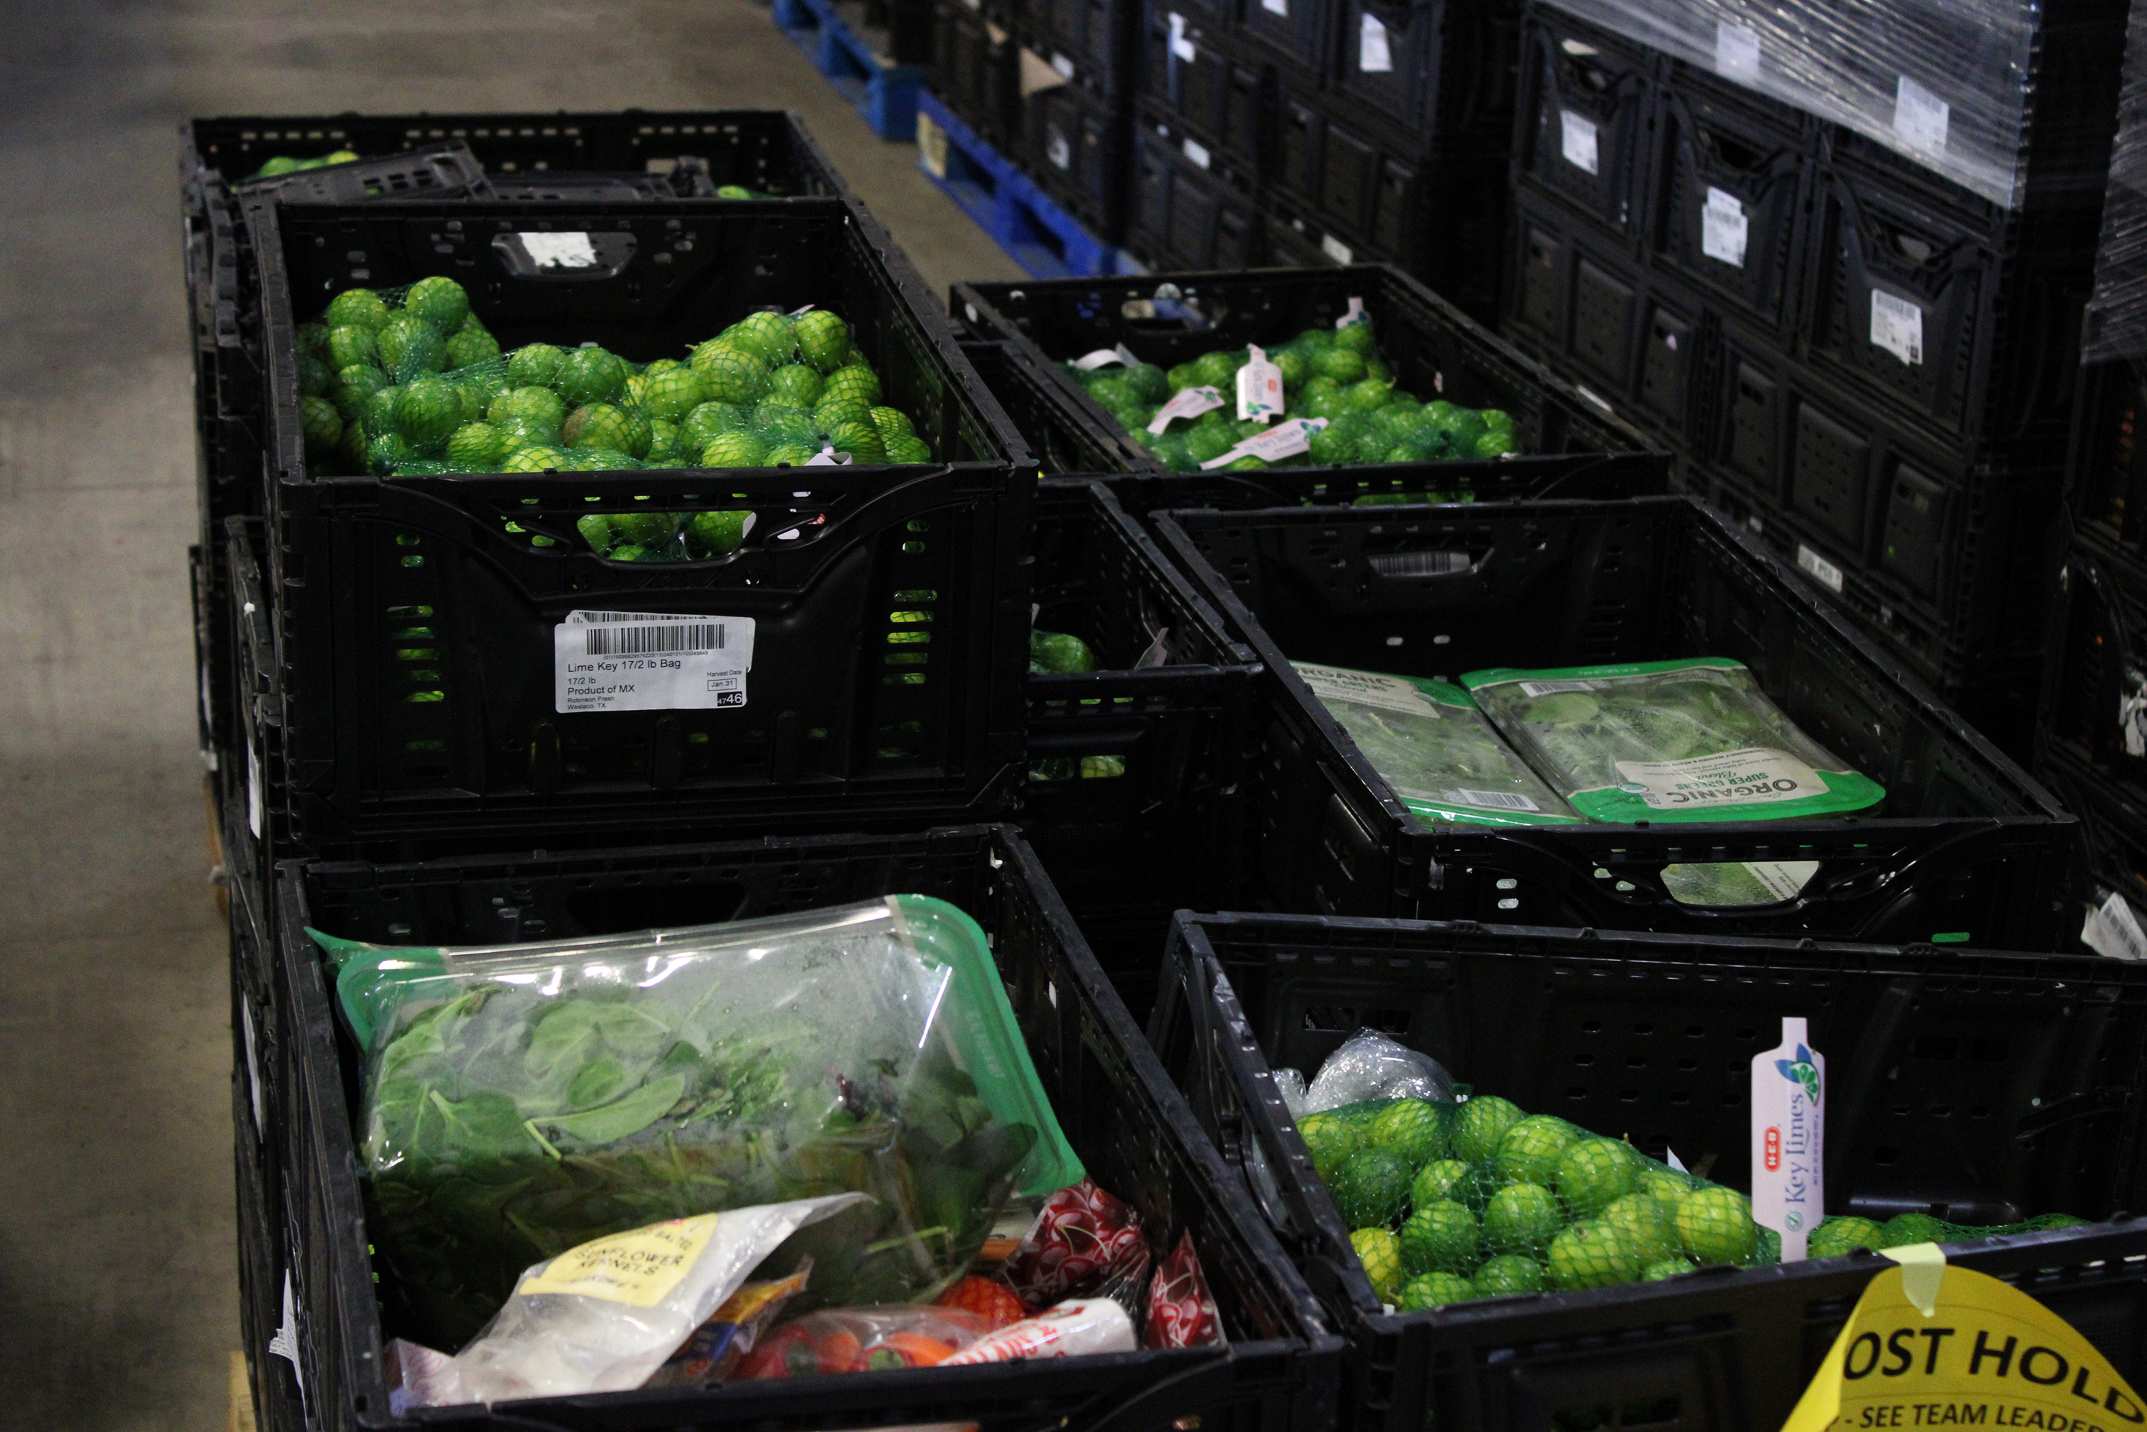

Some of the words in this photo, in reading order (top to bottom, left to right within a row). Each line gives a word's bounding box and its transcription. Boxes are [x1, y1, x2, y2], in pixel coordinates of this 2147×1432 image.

[567, 662, 595, 673] Lime
[597, 661, 618, 673] Key
[621, 659, 645, 671] 17/2
[647, 659, 657, 669] lb
[660, 658, 682, 670] Bag
[567, 677, 586, 685] 17/2
[588, 676, 597, 684] lb
[567, 686, 606, 696] Product
[606, 684, 617, 694] of
[618, 684, 636, 694] MX
[1675, 780, 1725, 790] GREENS
[1729, 772, 1769, 786] SUPER
[1667, 778, 1797, 803] ORGANIC
[1785, 1093, 1808, 1155] Limes
[1784, 1161, 1809, 1204] Key
[574, 1246, 684, 1266] SUNFLOWER
[1969, 1330, 2146, 1424] HOLD
[1859, 1405, 1905, 1428] SEE
[1912, 1403, 1989, 1426] TEAM
